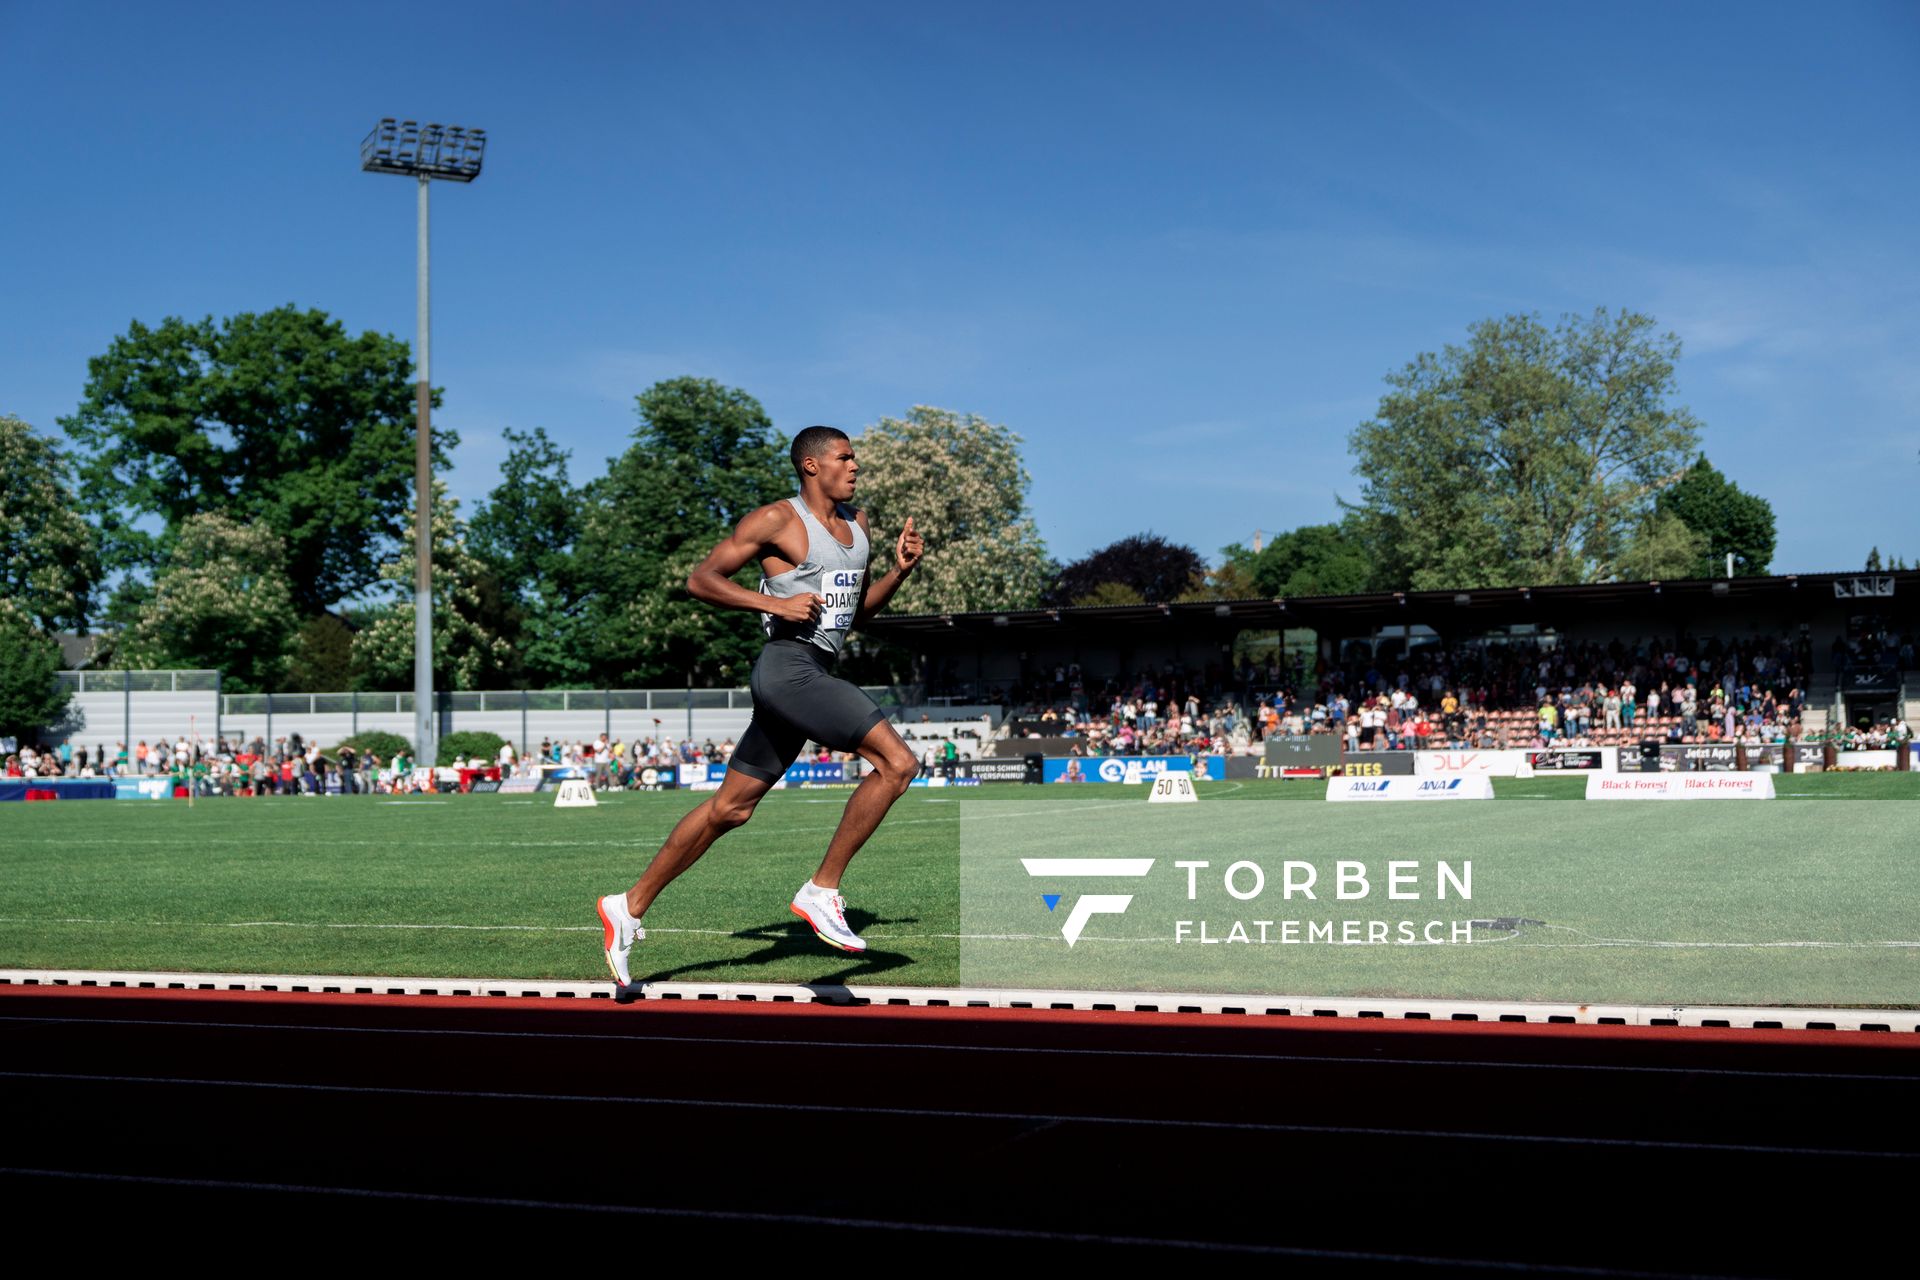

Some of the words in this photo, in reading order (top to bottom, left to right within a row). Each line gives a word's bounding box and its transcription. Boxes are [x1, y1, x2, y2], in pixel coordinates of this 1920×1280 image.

[834, 573, 858, 587] GLS
[1684, 748, 1710, 759] Jetzt
[1711, 748, 1732, 760] App
[971, 764, 996, 772] GEGEN
[1127, 760, 1168, 772] PLAN
[1433, 754, 1479, 770] DLV
[1157, 779, 1173, 795] 50
[1177, 779, 1190, 795] 50
[1349, 782, 1376, 792] ANA
[1417, 780, 1446, 791] ANA
[1601, 779, 1631, 789] Black
[1634, 780, 1668, 789] Forest
[1684, 778, 1714, 788] Black
[1718, 779, 1753, 788] Forest
[561, 787, 572, 801] 40
[577, 786, 590, 801] 40
